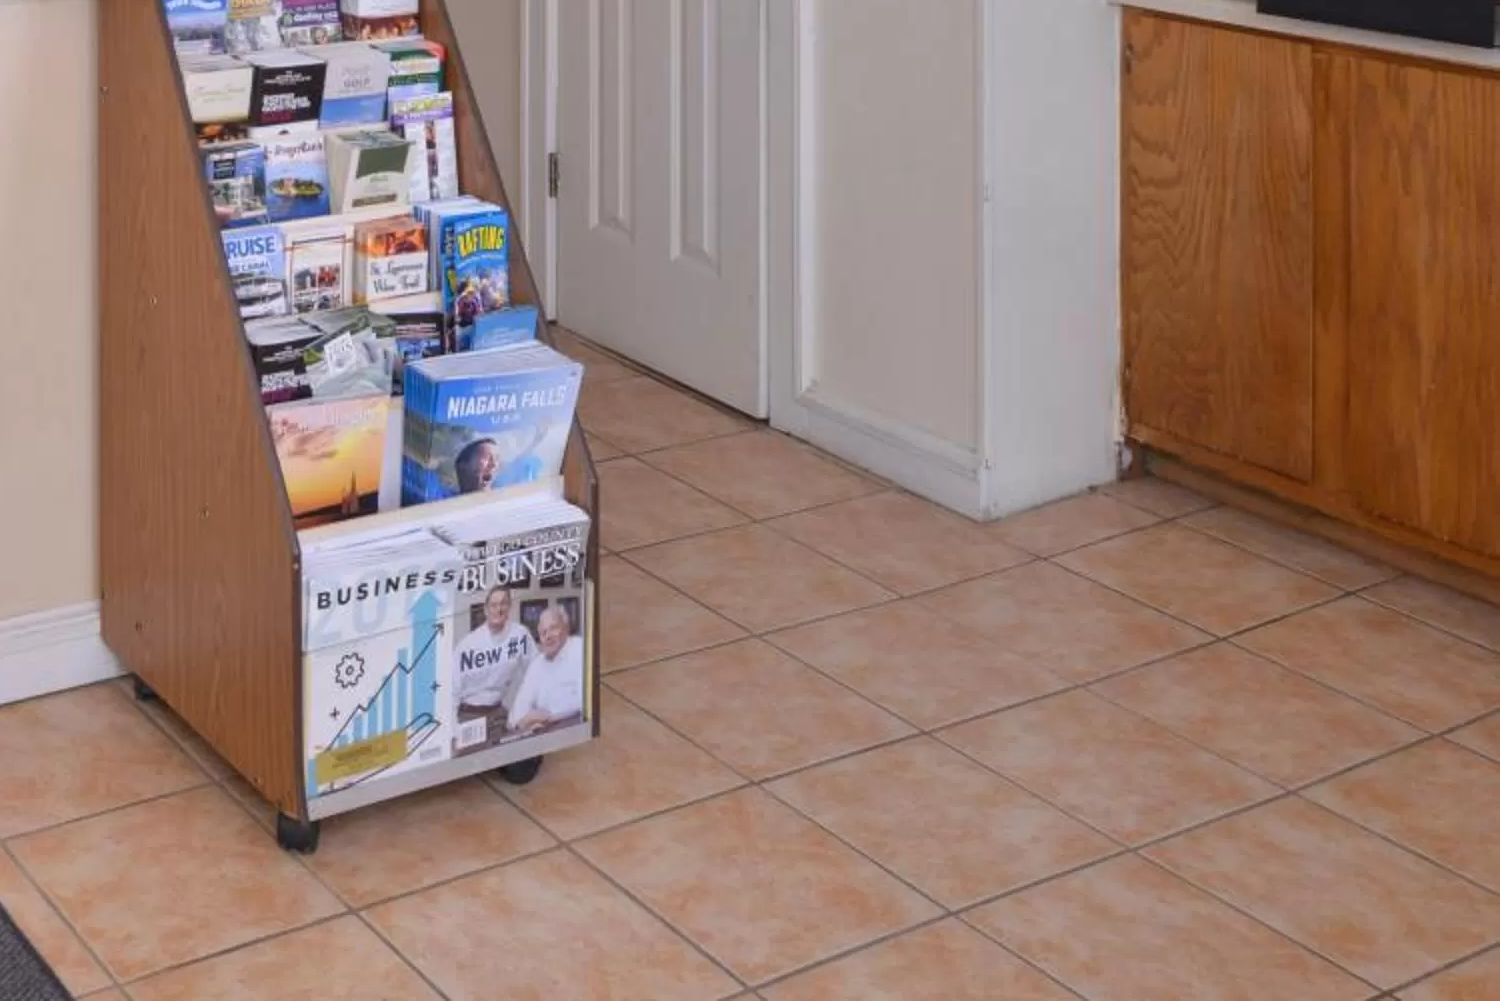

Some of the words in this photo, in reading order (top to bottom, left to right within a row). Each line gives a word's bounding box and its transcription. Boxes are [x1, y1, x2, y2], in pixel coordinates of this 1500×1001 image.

[456, 226, 505, 258] RAFTING
[448, 392, 517, 419] NIAGARA
[522, 385, 567, 408] FALLS
[460, 542, 581, 593] BUSINESS
[316, 568, 454, 610] BUSINESS
[460, 645, 500, 672] New
[507, 635, 529, 660] #1
